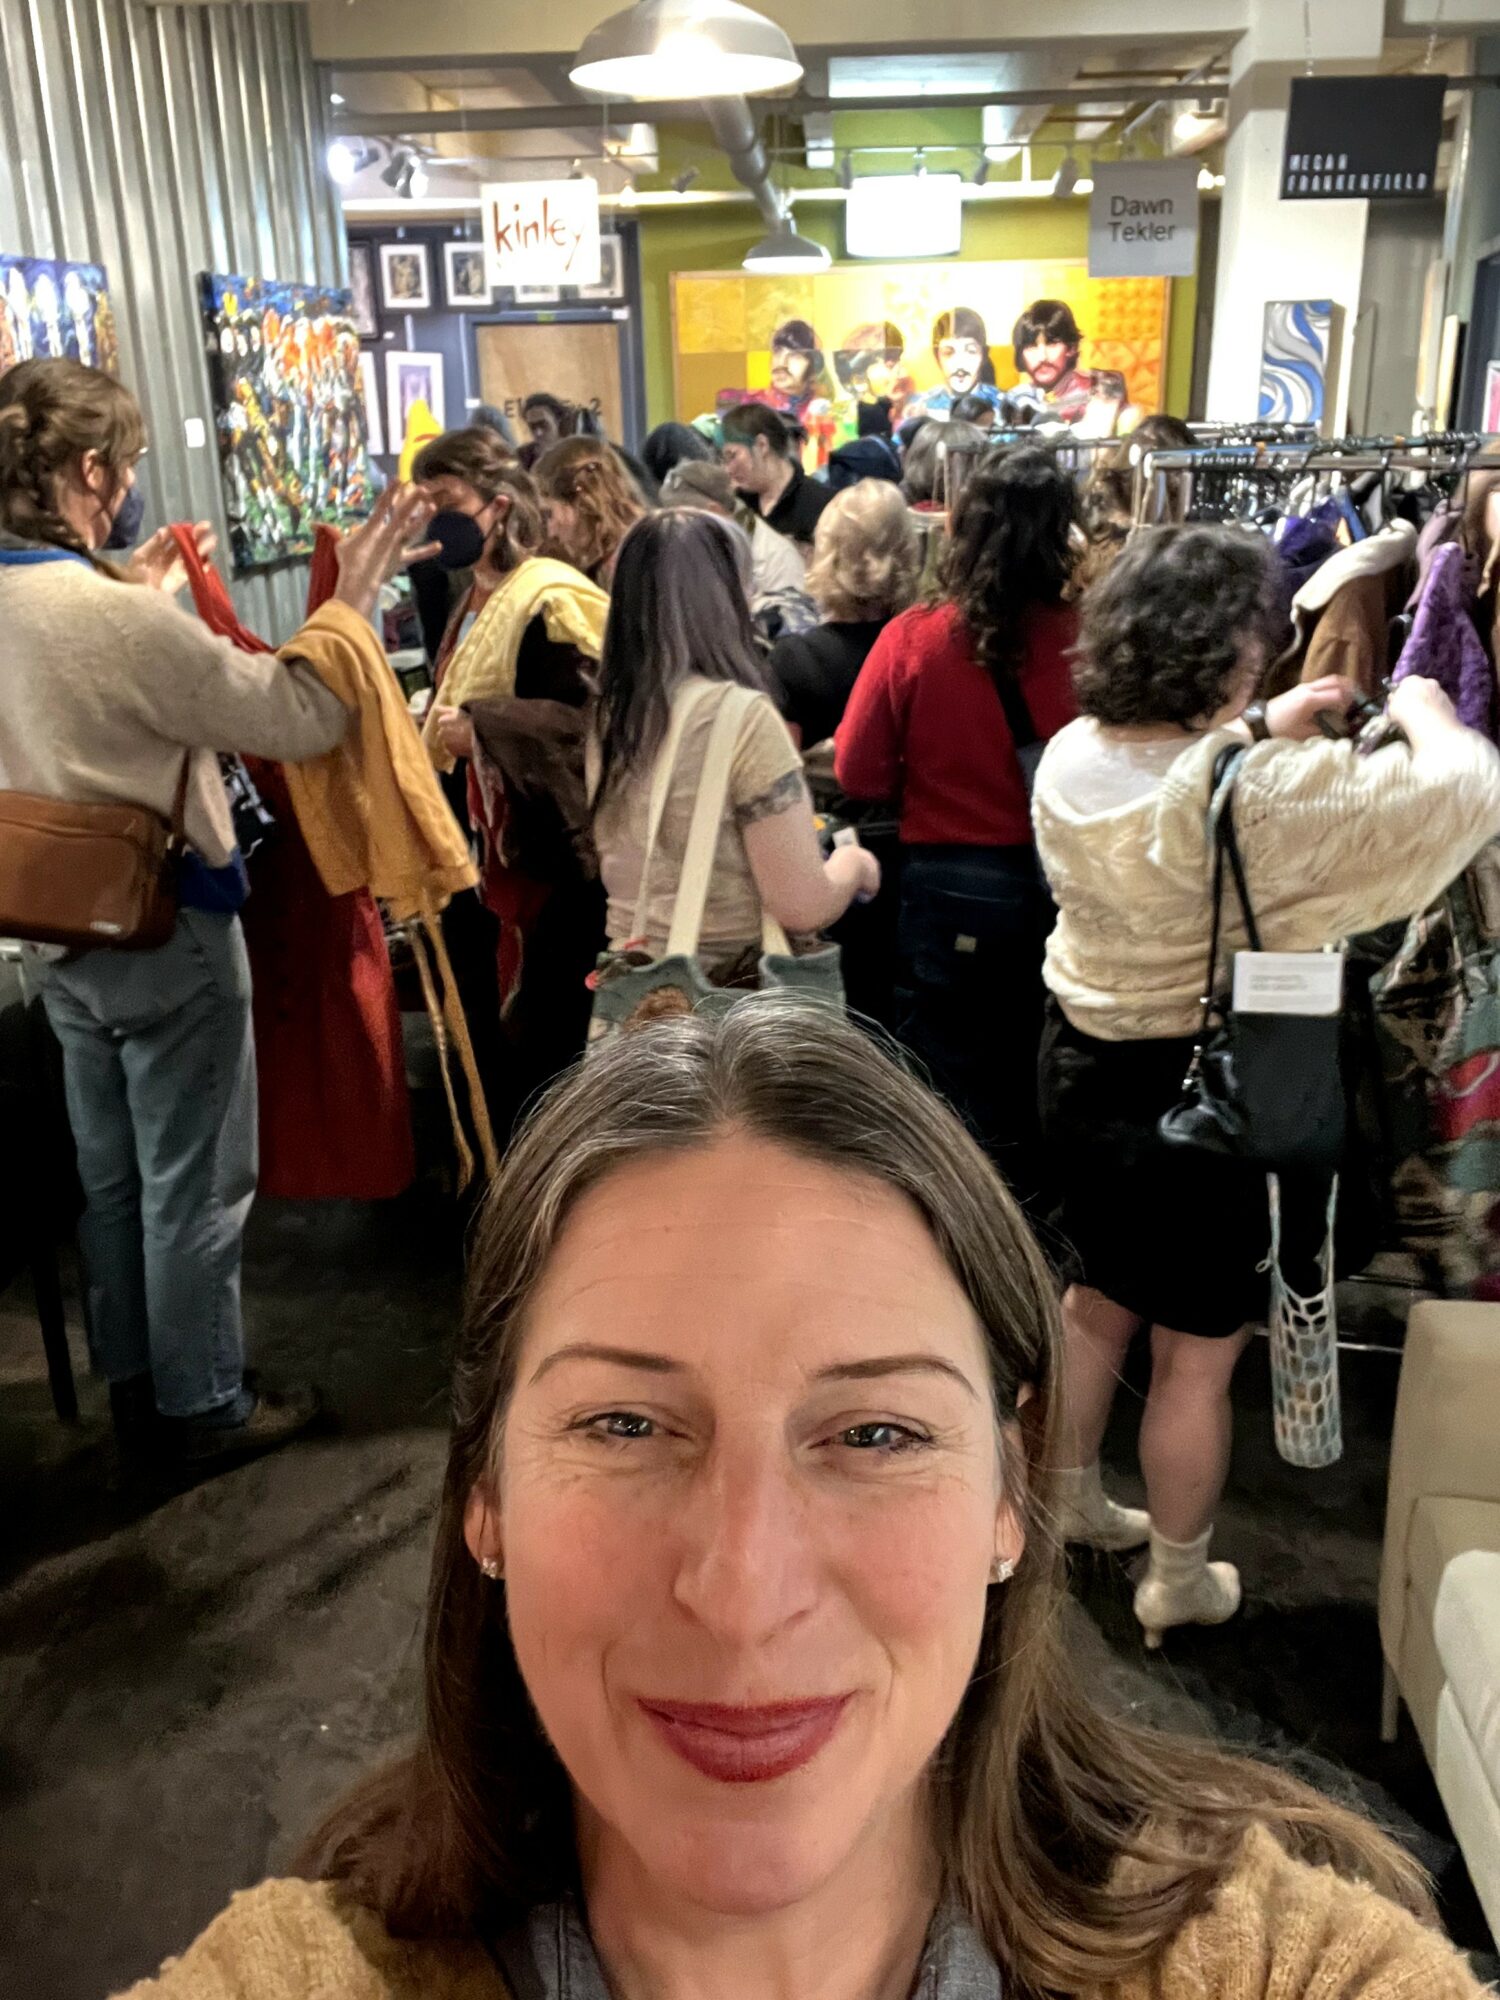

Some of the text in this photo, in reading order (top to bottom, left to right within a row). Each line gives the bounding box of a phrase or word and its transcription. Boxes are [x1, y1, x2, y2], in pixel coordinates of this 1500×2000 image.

[1109, 195, 1174, 217] Dawn
[492, 197, 585, 272] kinley
[1107, 221, 1177, 242] Tekler
